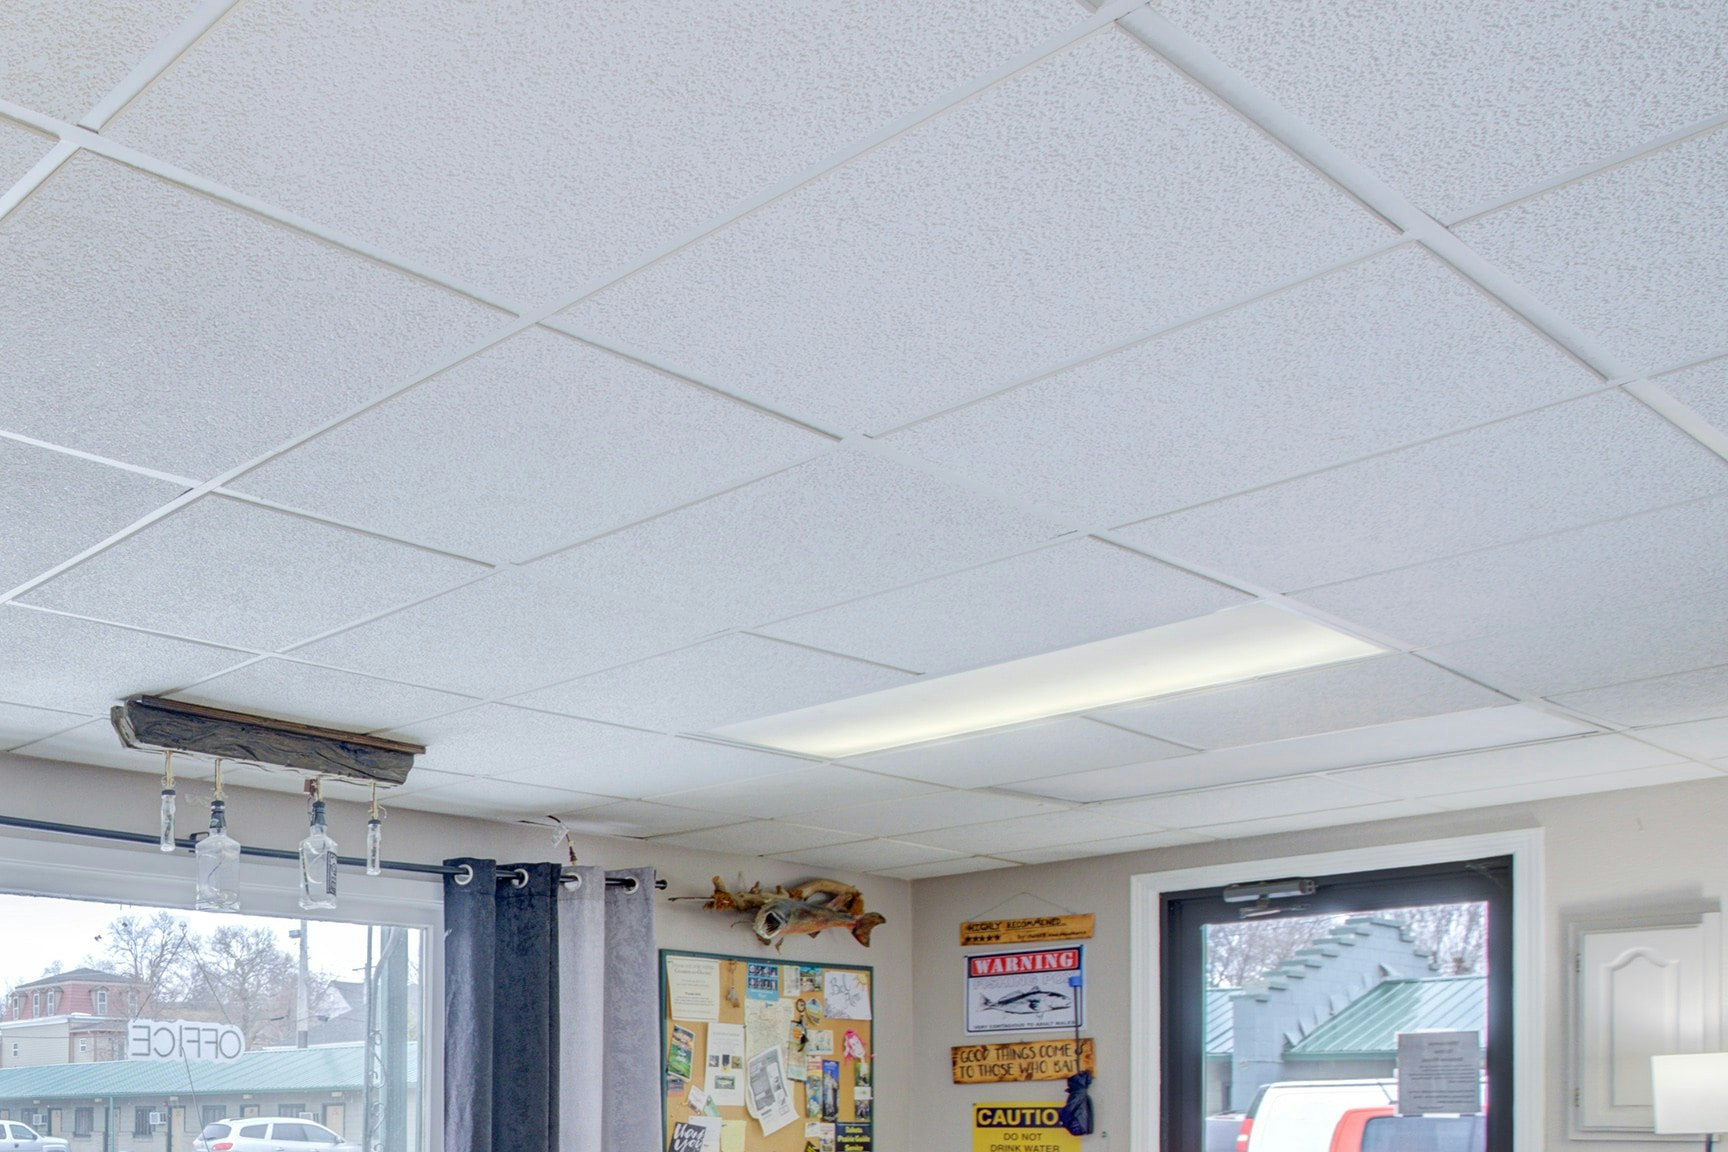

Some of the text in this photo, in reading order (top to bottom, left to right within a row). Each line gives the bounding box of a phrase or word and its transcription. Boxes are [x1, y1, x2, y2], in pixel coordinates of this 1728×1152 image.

[975, 952, 1074, 974] WARNING
[960, 1043, 1072, 1063] GOOD THINGS COME
[959, 1065, 973, 1078] TO
[975, 1063, 1014, 1077] THOSE
[1019, 1060, 1048, 1074] WHO
[977, 1108, 1064, 1125] CAUTIO
[1003, 1133, 1042, 1141] DO NOT
[990, 1144, 1060, 1152] DRINK WATER
